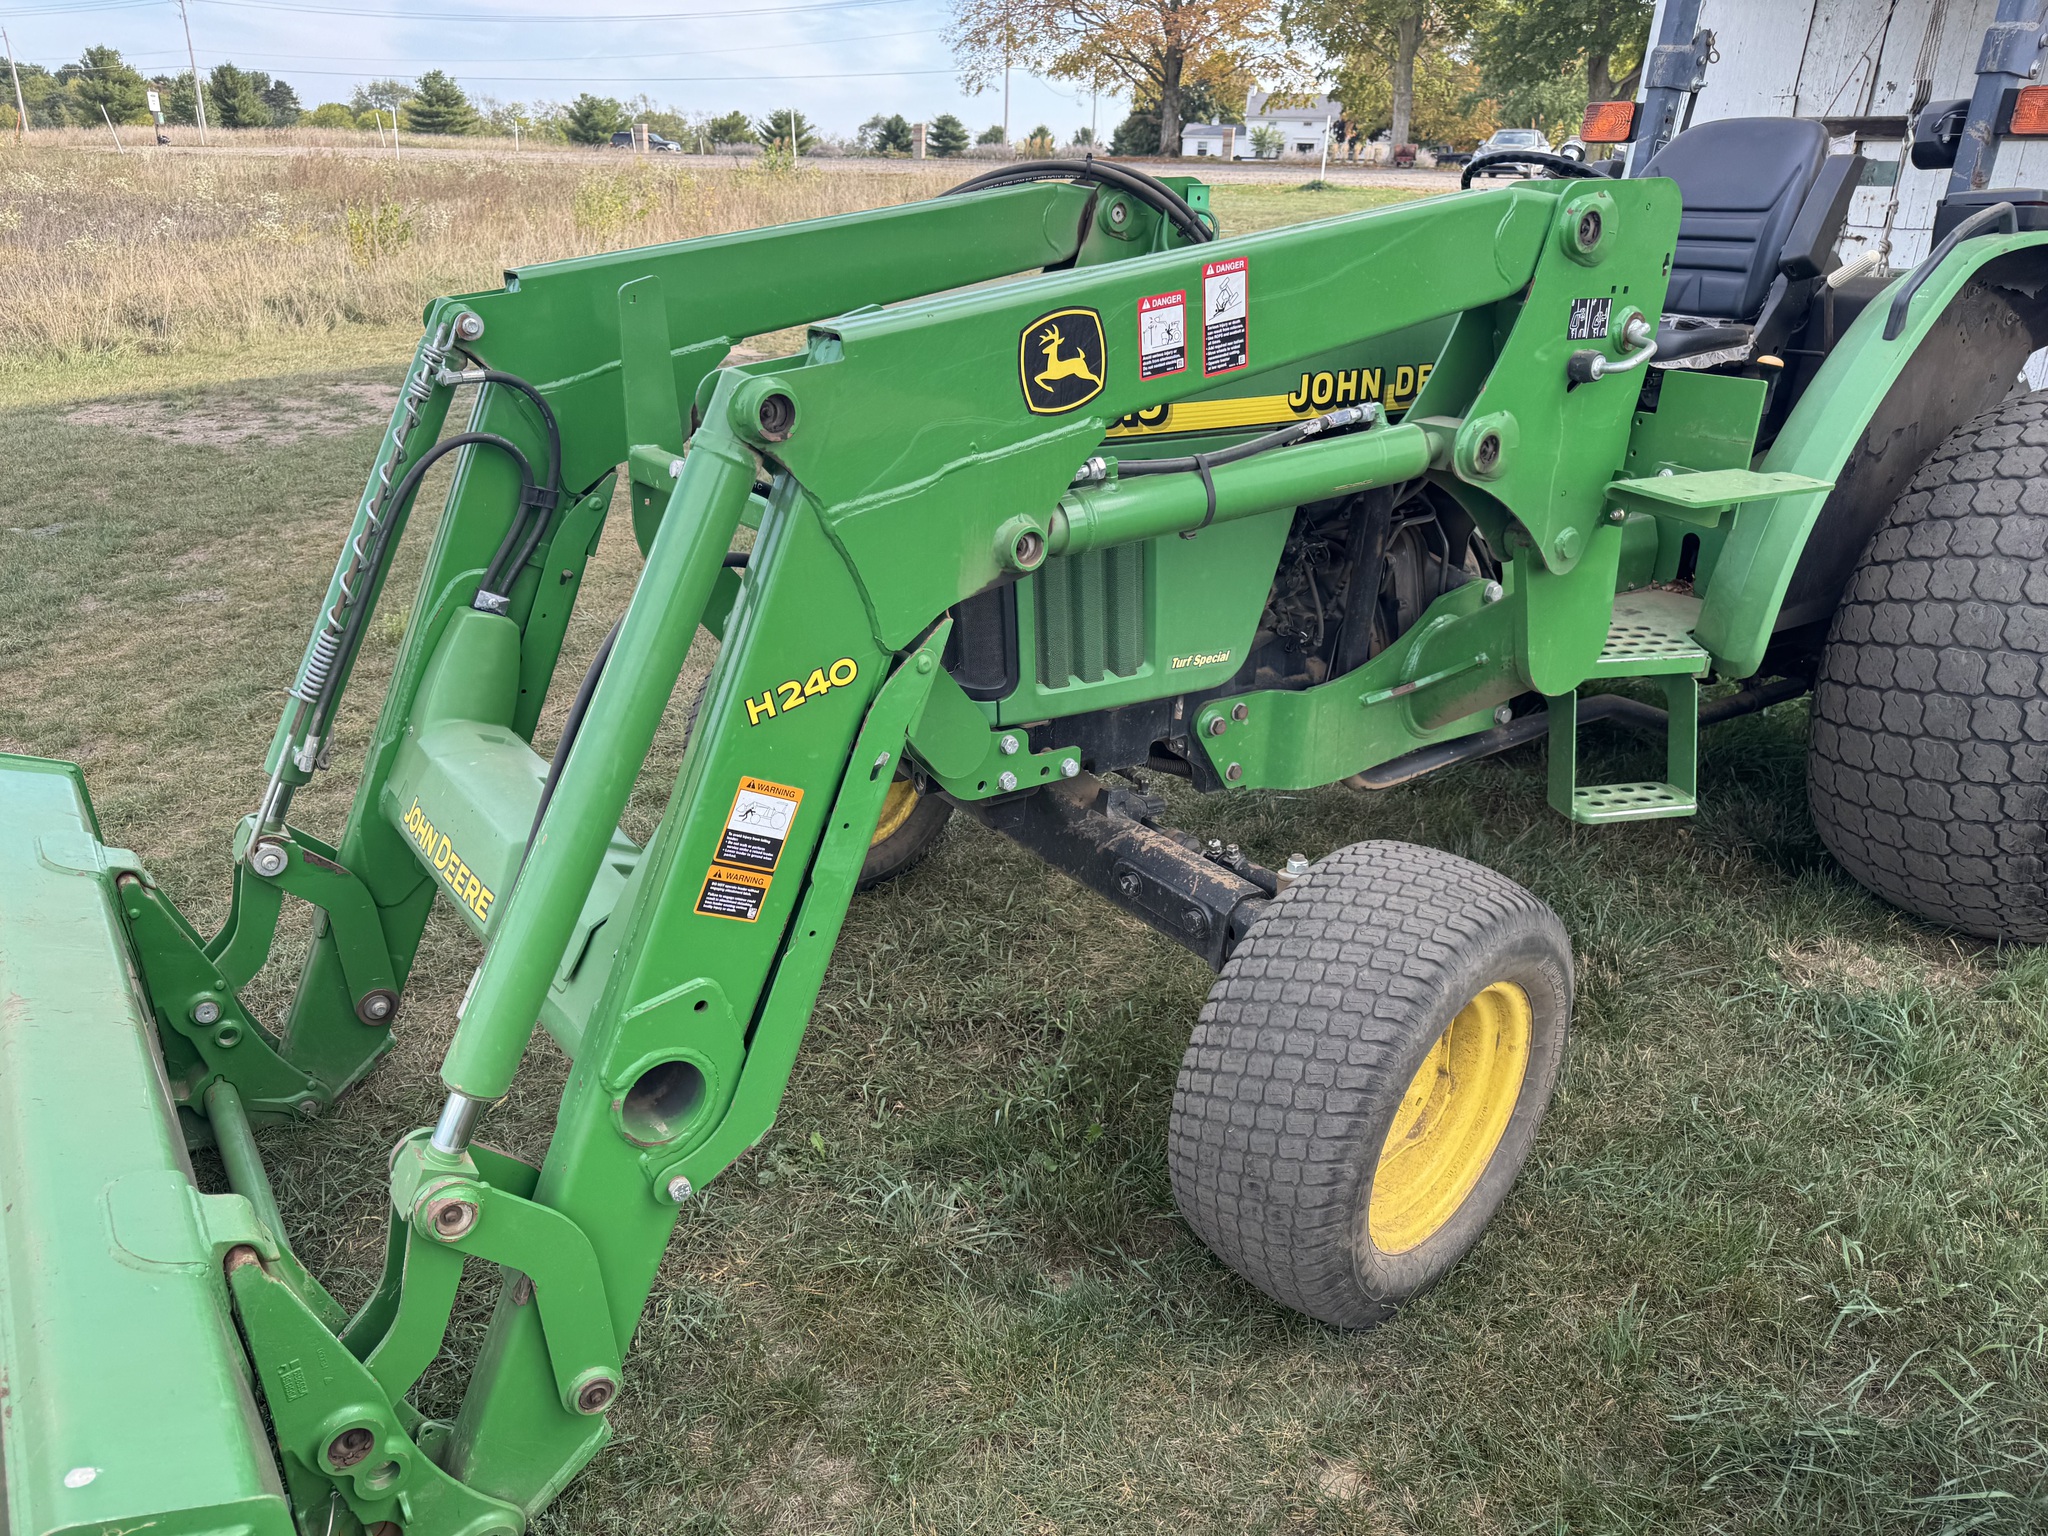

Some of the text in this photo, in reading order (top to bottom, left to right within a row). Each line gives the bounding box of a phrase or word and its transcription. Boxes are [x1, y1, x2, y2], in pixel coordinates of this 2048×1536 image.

[1216, 260, 1244, 273] DANGER
[1152, 294, 1182, 308] DANGER
[1288, 367, 1384, 414] JOHN
[1171, 649, 1231, 669] Turf Special
[744, 657, 858, 727] H240
[757, 783, 796, 798] WARNING
[403, 795, 496, 923] JOHN DEERE
[726, 872, 764, 886] WARNING
[1537, 957, 1566, 1008] MULTI
[1545, 1013, 1566, 1089] TRAC
